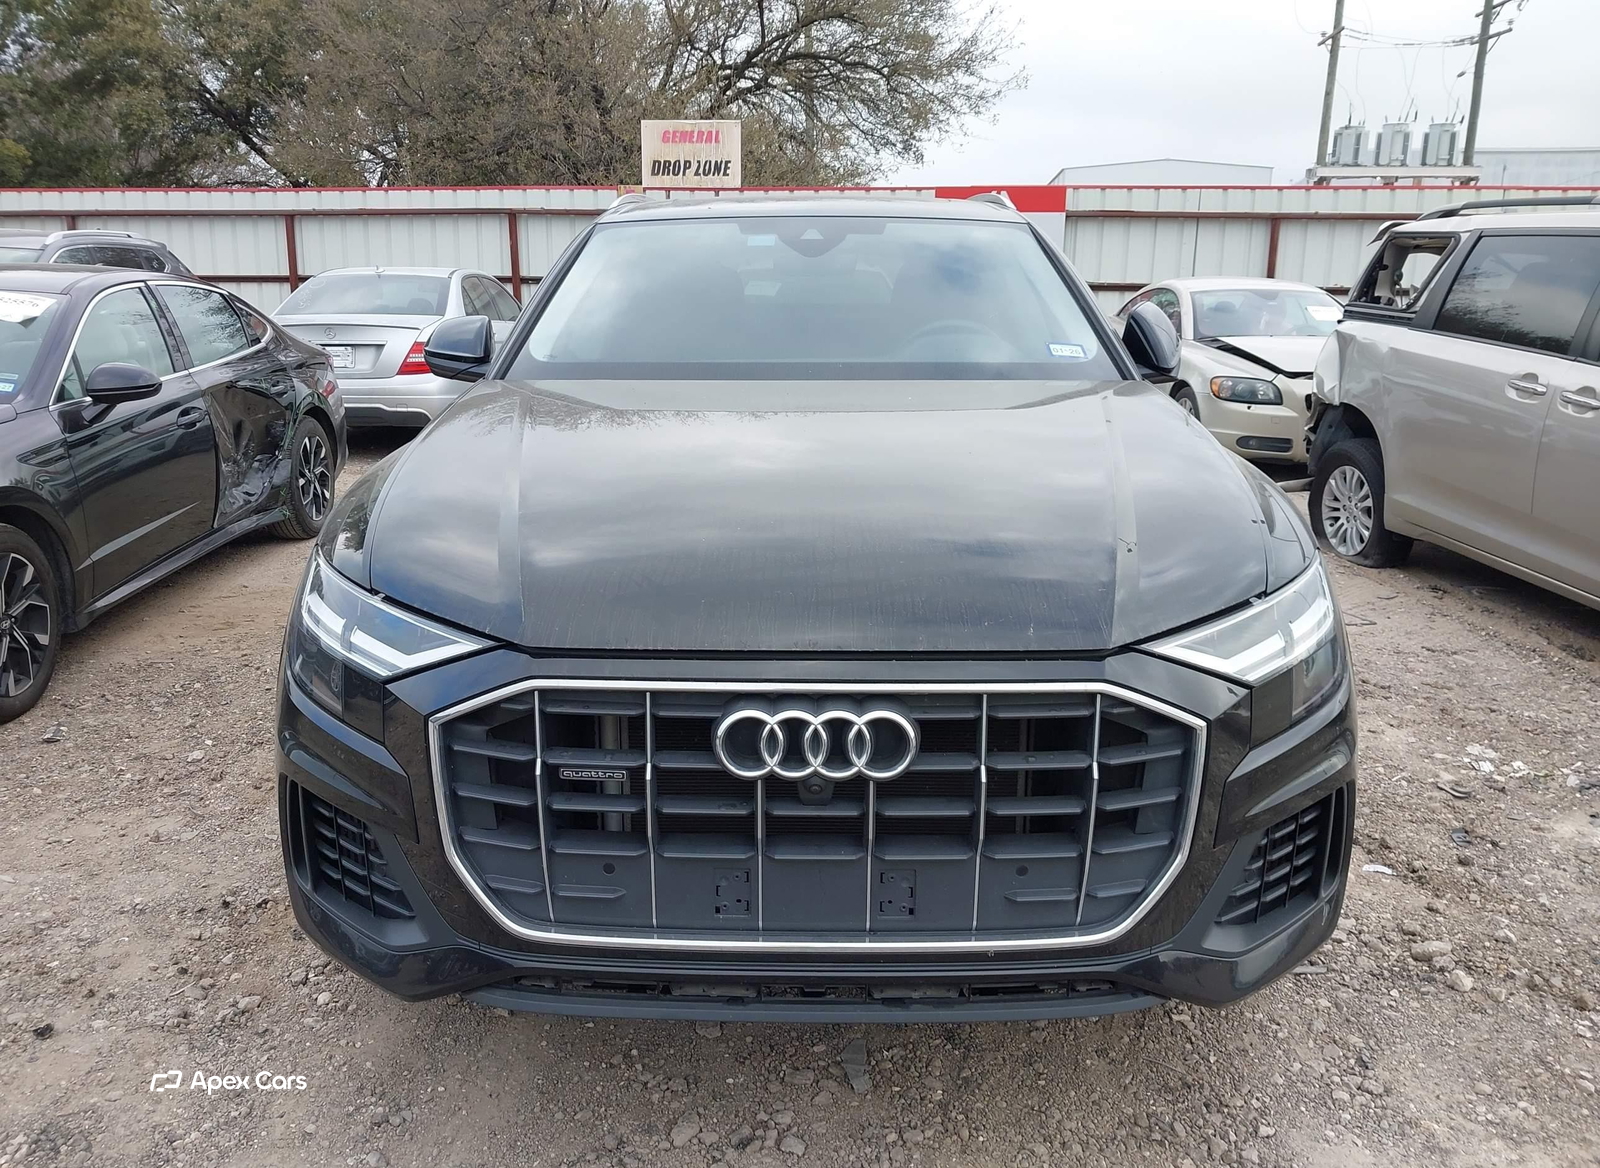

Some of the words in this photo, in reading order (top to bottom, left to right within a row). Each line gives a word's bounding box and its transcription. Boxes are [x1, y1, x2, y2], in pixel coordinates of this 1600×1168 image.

[661, 129, 720, 144] GENERAL
[650, 159, 692, 177] DROP
[693, 159, 731, 177] ZONE
